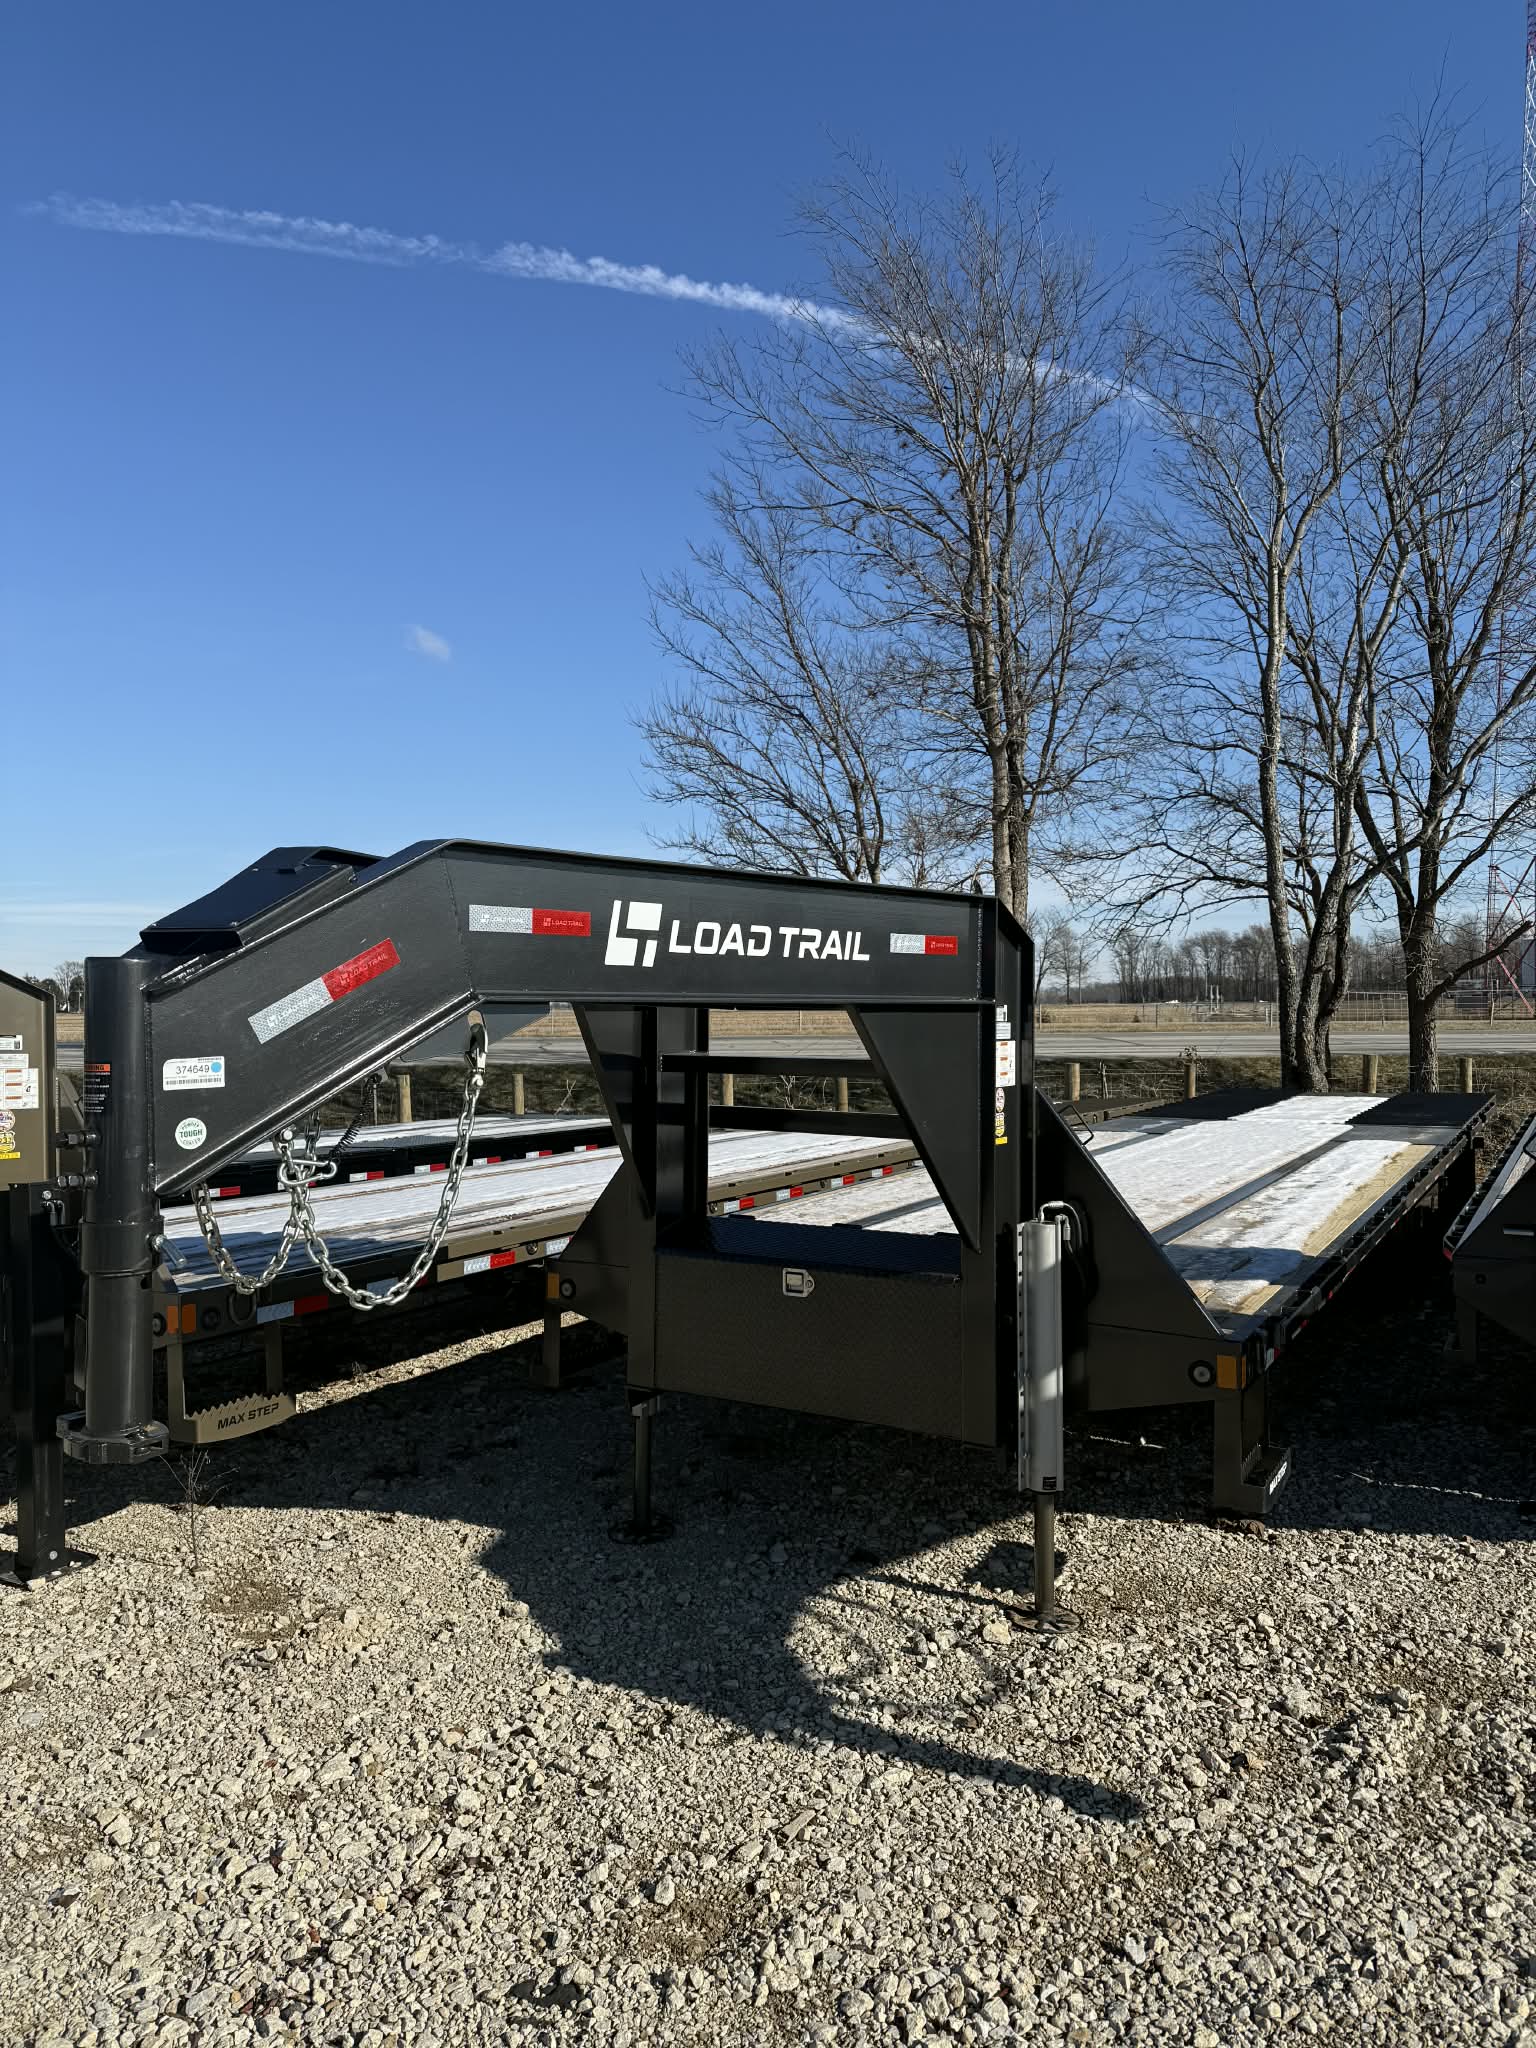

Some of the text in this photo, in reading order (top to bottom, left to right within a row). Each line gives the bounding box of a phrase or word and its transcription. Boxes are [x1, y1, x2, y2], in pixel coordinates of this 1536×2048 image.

[669, 919, 870, 961] LOAD TRAIL
[175, 1064, 210, 1075] 374649
[179, 1129, 203, 1138] TOUGH
[217, 1402, 279, 1430] MAX STEP
